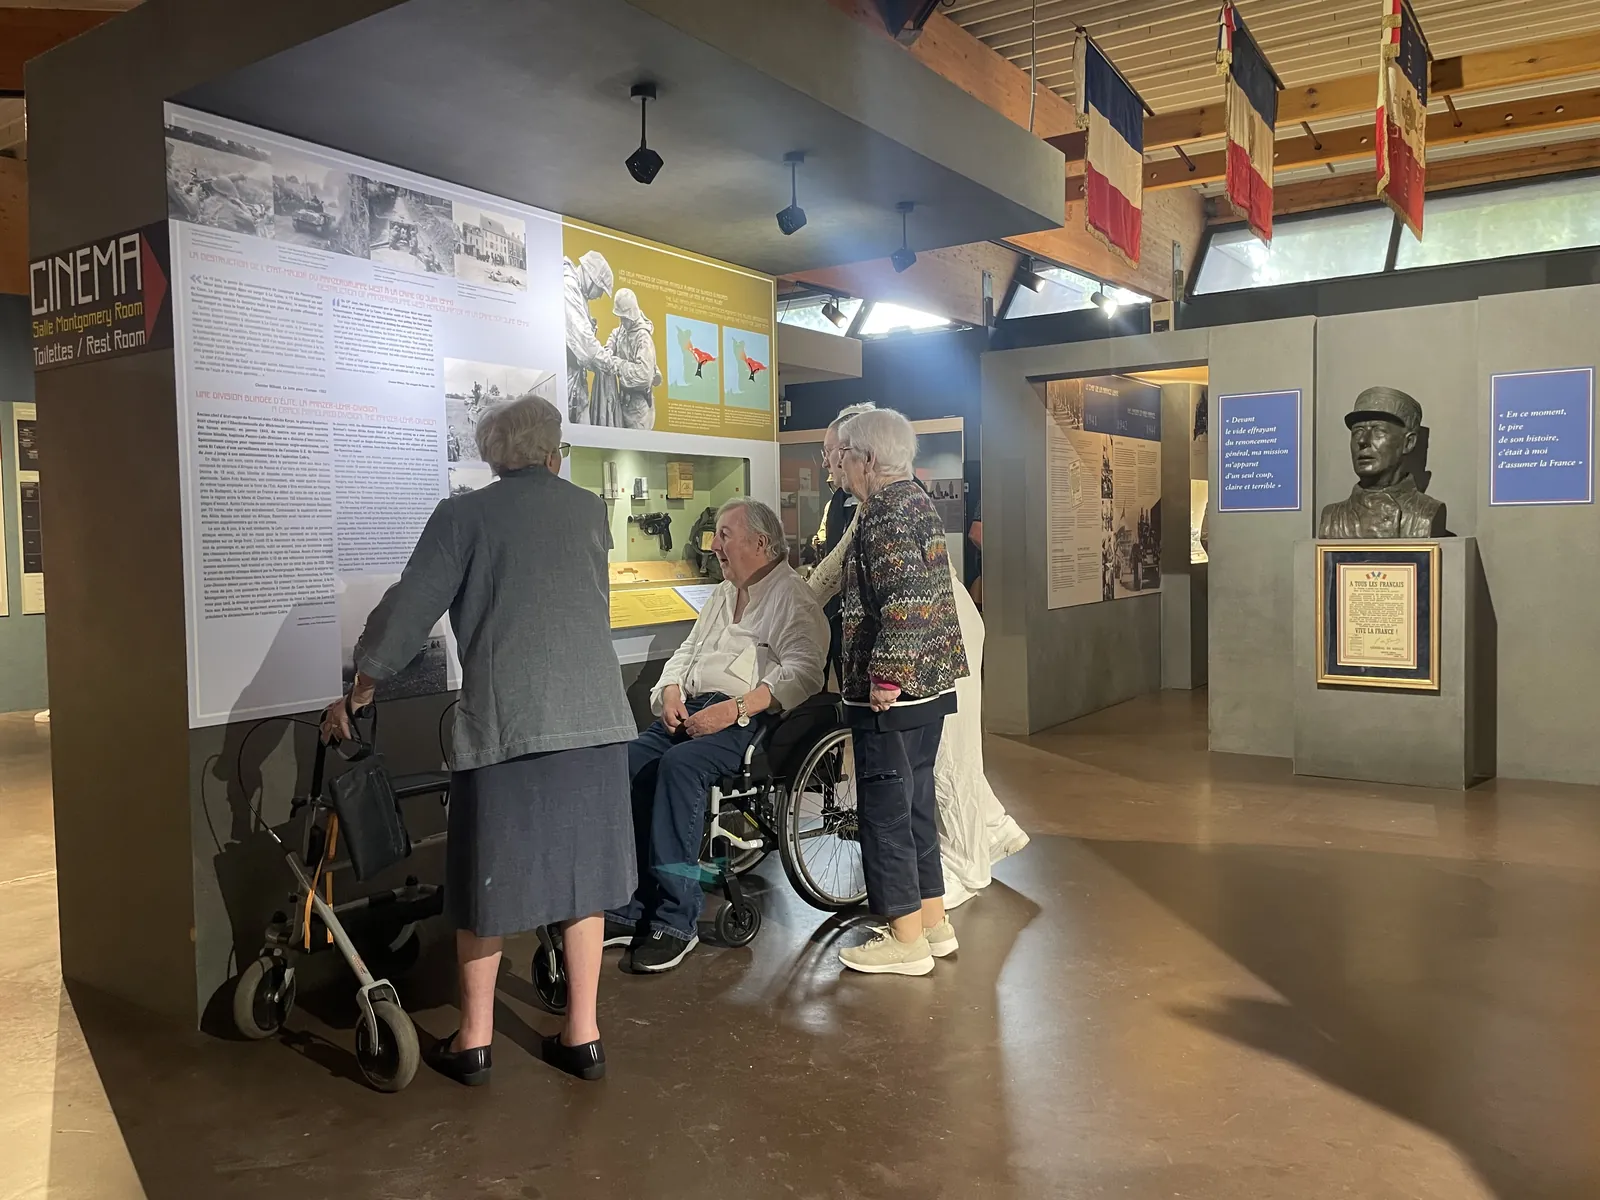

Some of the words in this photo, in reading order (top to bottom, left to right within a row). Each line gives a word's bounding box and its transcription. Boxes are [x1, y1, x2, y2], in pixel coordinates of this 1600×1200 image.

[30, 233, 142, 316] CINEMA
[33, 320, 54, 338] Salle
[56, 309, 113, 333] Montgomery
[115, 302, 143, 320] Room
[33, 344, 74, 365] Toilettes
[77, 337, 83, 358] /
[86, 333, 112, 355] Rest
[114, 330, 146, 350] Room
[212, 391, 243, 401] DIVISION
[1506, 410, 1518, 418] En
[1530, 409, 1567, 417] moment,
[1231, 416, 1255, 424] Devant
[1232, 427, 1246, 435] vide
[1247, 426, 1277, 435] effrayant
[1507, 424, 1524, 432] pire
[1236, 438, 1277, 446] renoncement
[1526, 434, 1559, 442] histoire,
[1225, 450, 1250, 459] général,
[1498, 448, 1522, 456] c'était
[1531, 447, 1548, 455] moi
[1225, 461, 1259, 469] m'apparut
[1498, 461, 1538, 469] d'assumer
[1549, 459, 1576, 467] France
[1252, 482, 1276, 490] terrible
